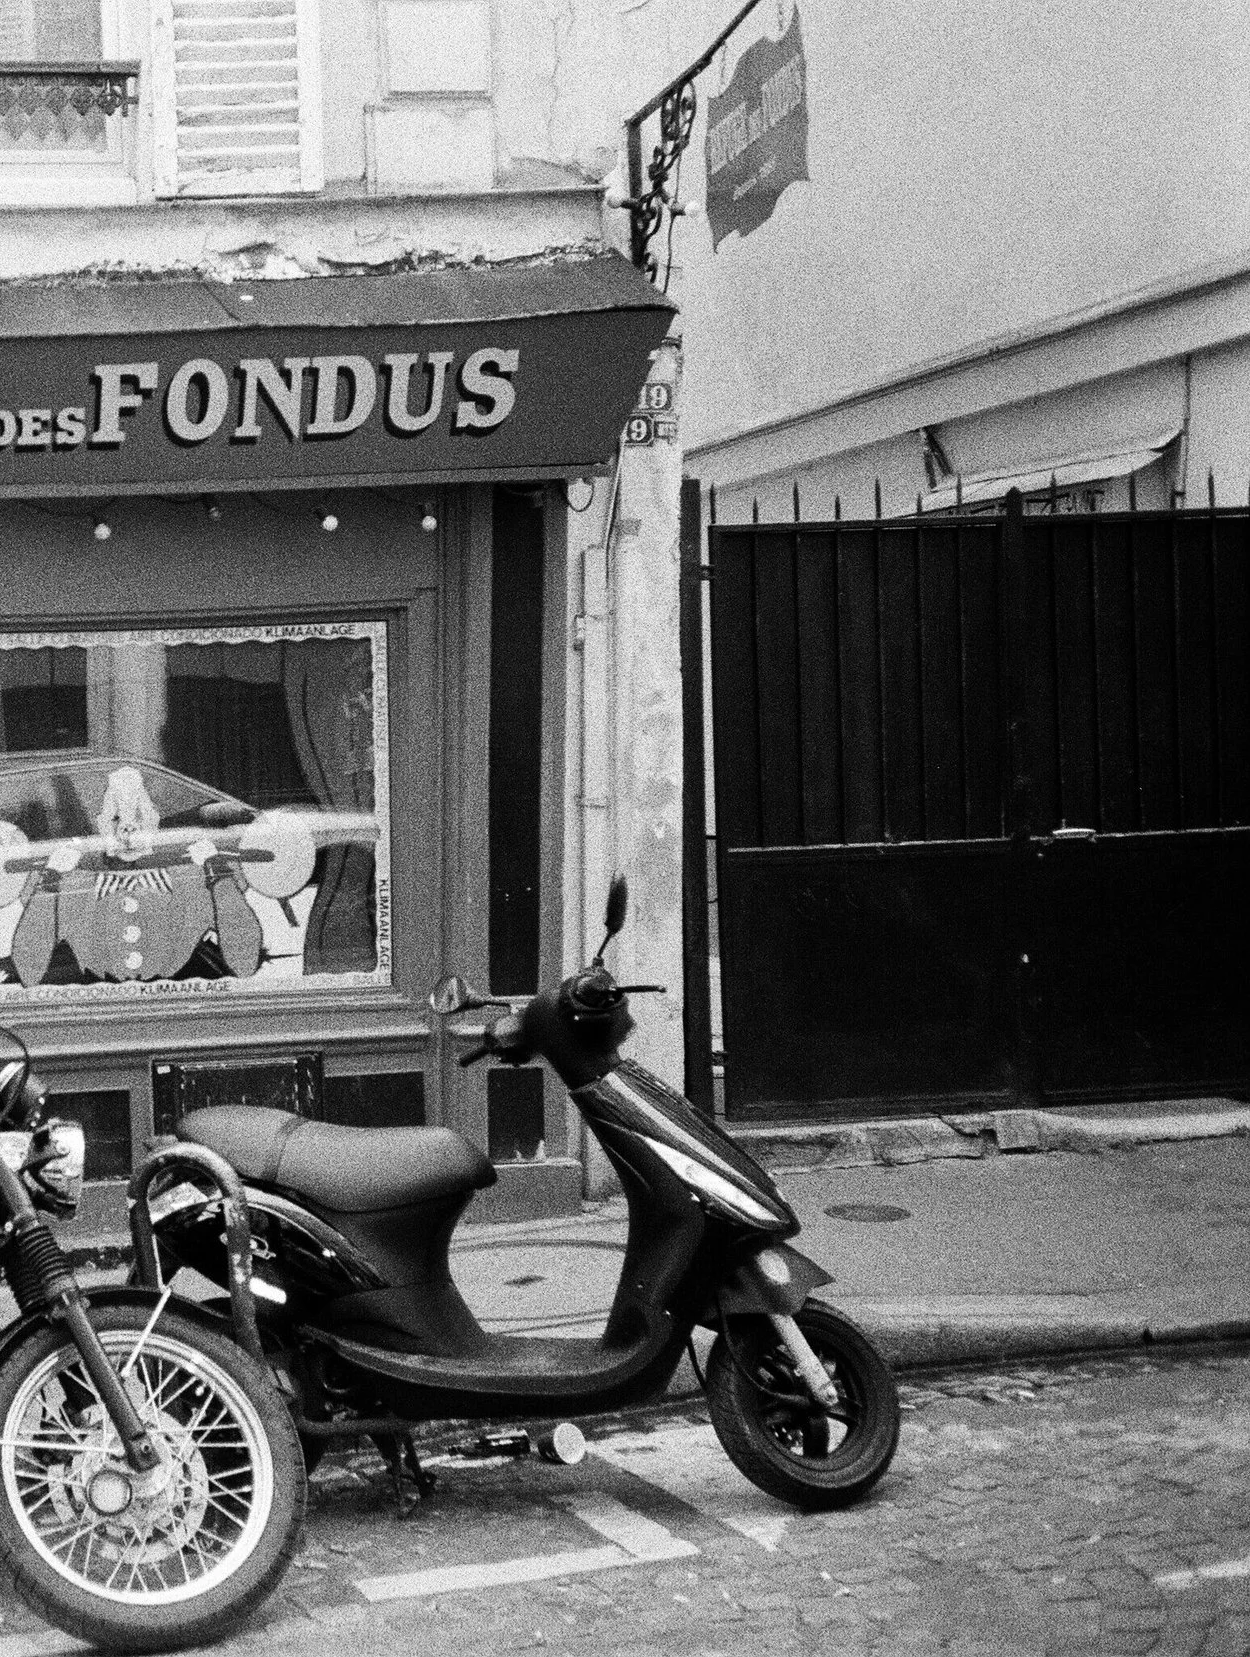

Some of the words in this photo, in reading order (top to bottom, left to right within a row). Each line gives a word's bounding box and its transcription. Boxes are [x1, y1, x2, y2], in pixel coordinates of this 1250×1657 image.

[91, 346, 520, 444] FONDUS
[266, 623, 356, 637] KLIMAANLAGE
[378, 879, 389, 967] KLIMAANLAGE
[140, 980, 231, 995] KLIMAANLAGE
